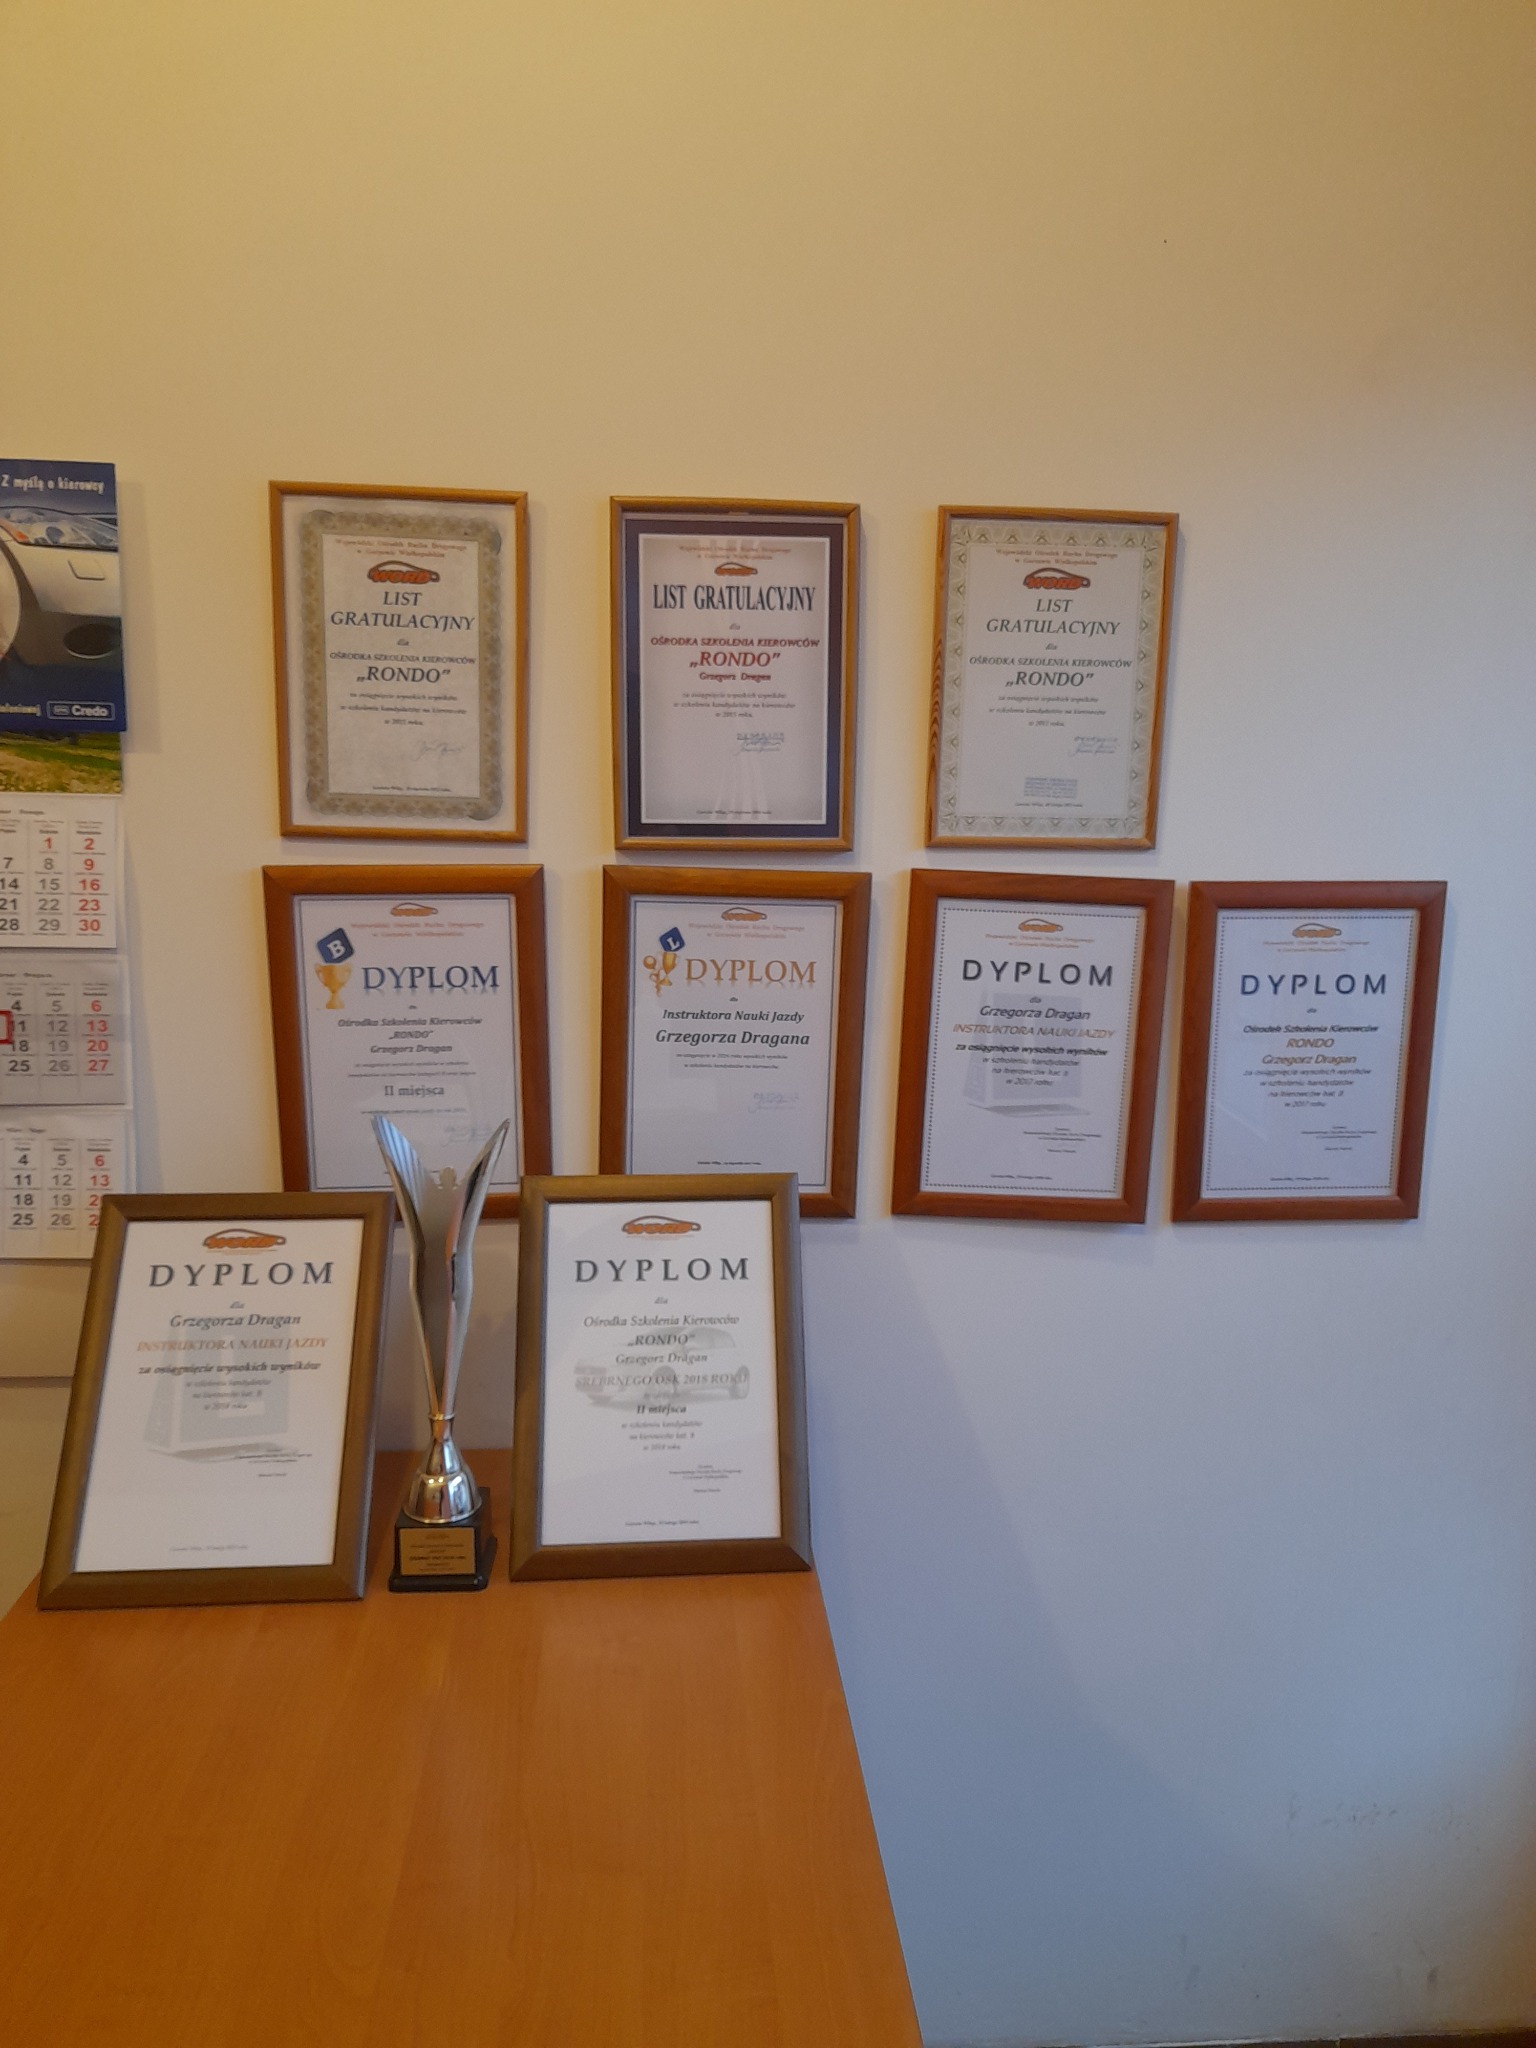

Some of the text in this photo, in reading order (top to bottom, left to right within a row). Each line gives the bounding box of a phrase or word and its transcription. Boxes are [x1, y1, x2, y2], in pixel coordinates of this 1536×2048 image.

[383, 591, 423, 606] LIST
[653, 584, 816, 612] LIST GRATULACYJNY
[1036, 599, 1073, 613] LIST
[330, 611, 475, 632] GRATULACYJNY
[986, 619, 1120, 638] GRATULACYJNY
[651, 636, 820, 648] OŚRODKA SZKOLENIA KIEROWCÓW
[330, 651, 371, 661] OŚRODKA
[373, 653, 420, 662] SZKOLENIA
[969, 656, 1132, 668] OŚRODKA SZKOLENIA KIEROWCÓW
[71, 705, 109, 717] Credo
[44, 837, 95, 850] 1 2
[3, 857, 94, 871] 7 8 9
[0, 878, 101, 891] 14 15 16
[0, 898, 101, 911] 21 22 23
[0, 918, 101, 932] 28 29 30
[327, 940, 346, 959] B
[667, 937, 681, 951] L
[685, 958, 817, 984] DYPLOM
[962, 959, 1113, 987] DYPLOM
[361, 966, 500, 990] DYPLOM
[1240, 974, 1386, 995] DYPLOM
[11, 1000, 102, 1012] 4 5 6
[662, 1009, 805, 1024] Instruktora Nauki Jazdy
[979, 1005, 1091, 1022] Grzegorza Dragan
[47, 1020, 68, 1032] 12
[86, 1020, 108, 1032] 13
[953, 1023, 1034, 1035] INSTRUKTORA
[655, 1029, 811, 1048] Grzegorza Dragana
[1286, 1038, 1335, 1048] RONDO
[11, 1040, 109, 1052] 18 19 20
[8, 1059, 109, 1072] 25 26 27
[1262, 1054, 1357, 1066] Grzegorz Dragan
[384, 1085, 444, 1098] II miejsca
[18, 1154, 105, 1167] 4 5 6
[14, 1174, 110, 1187] 11 12 13
[14, 1194, 34, 1206] 18
[52, 1194, 72, 1206] 19
[13, 1213, 34, 1226] 25
[50, 1213, 72, 1226] 26
[149, 1261, 334, 1287] DYPLOM
[575, 1257, 749, 1283] DYPLOM
[170, 1313, 301, 1330] Grzegorza Dragan
[584, 1315, 628, 1327] Ośrodka
[630, 1315, 679, 1326] Szkolenia
[616, 1352, 708, 1366] Grzegorz Dragan
[648, 1403, 688, 1416] miejsca
